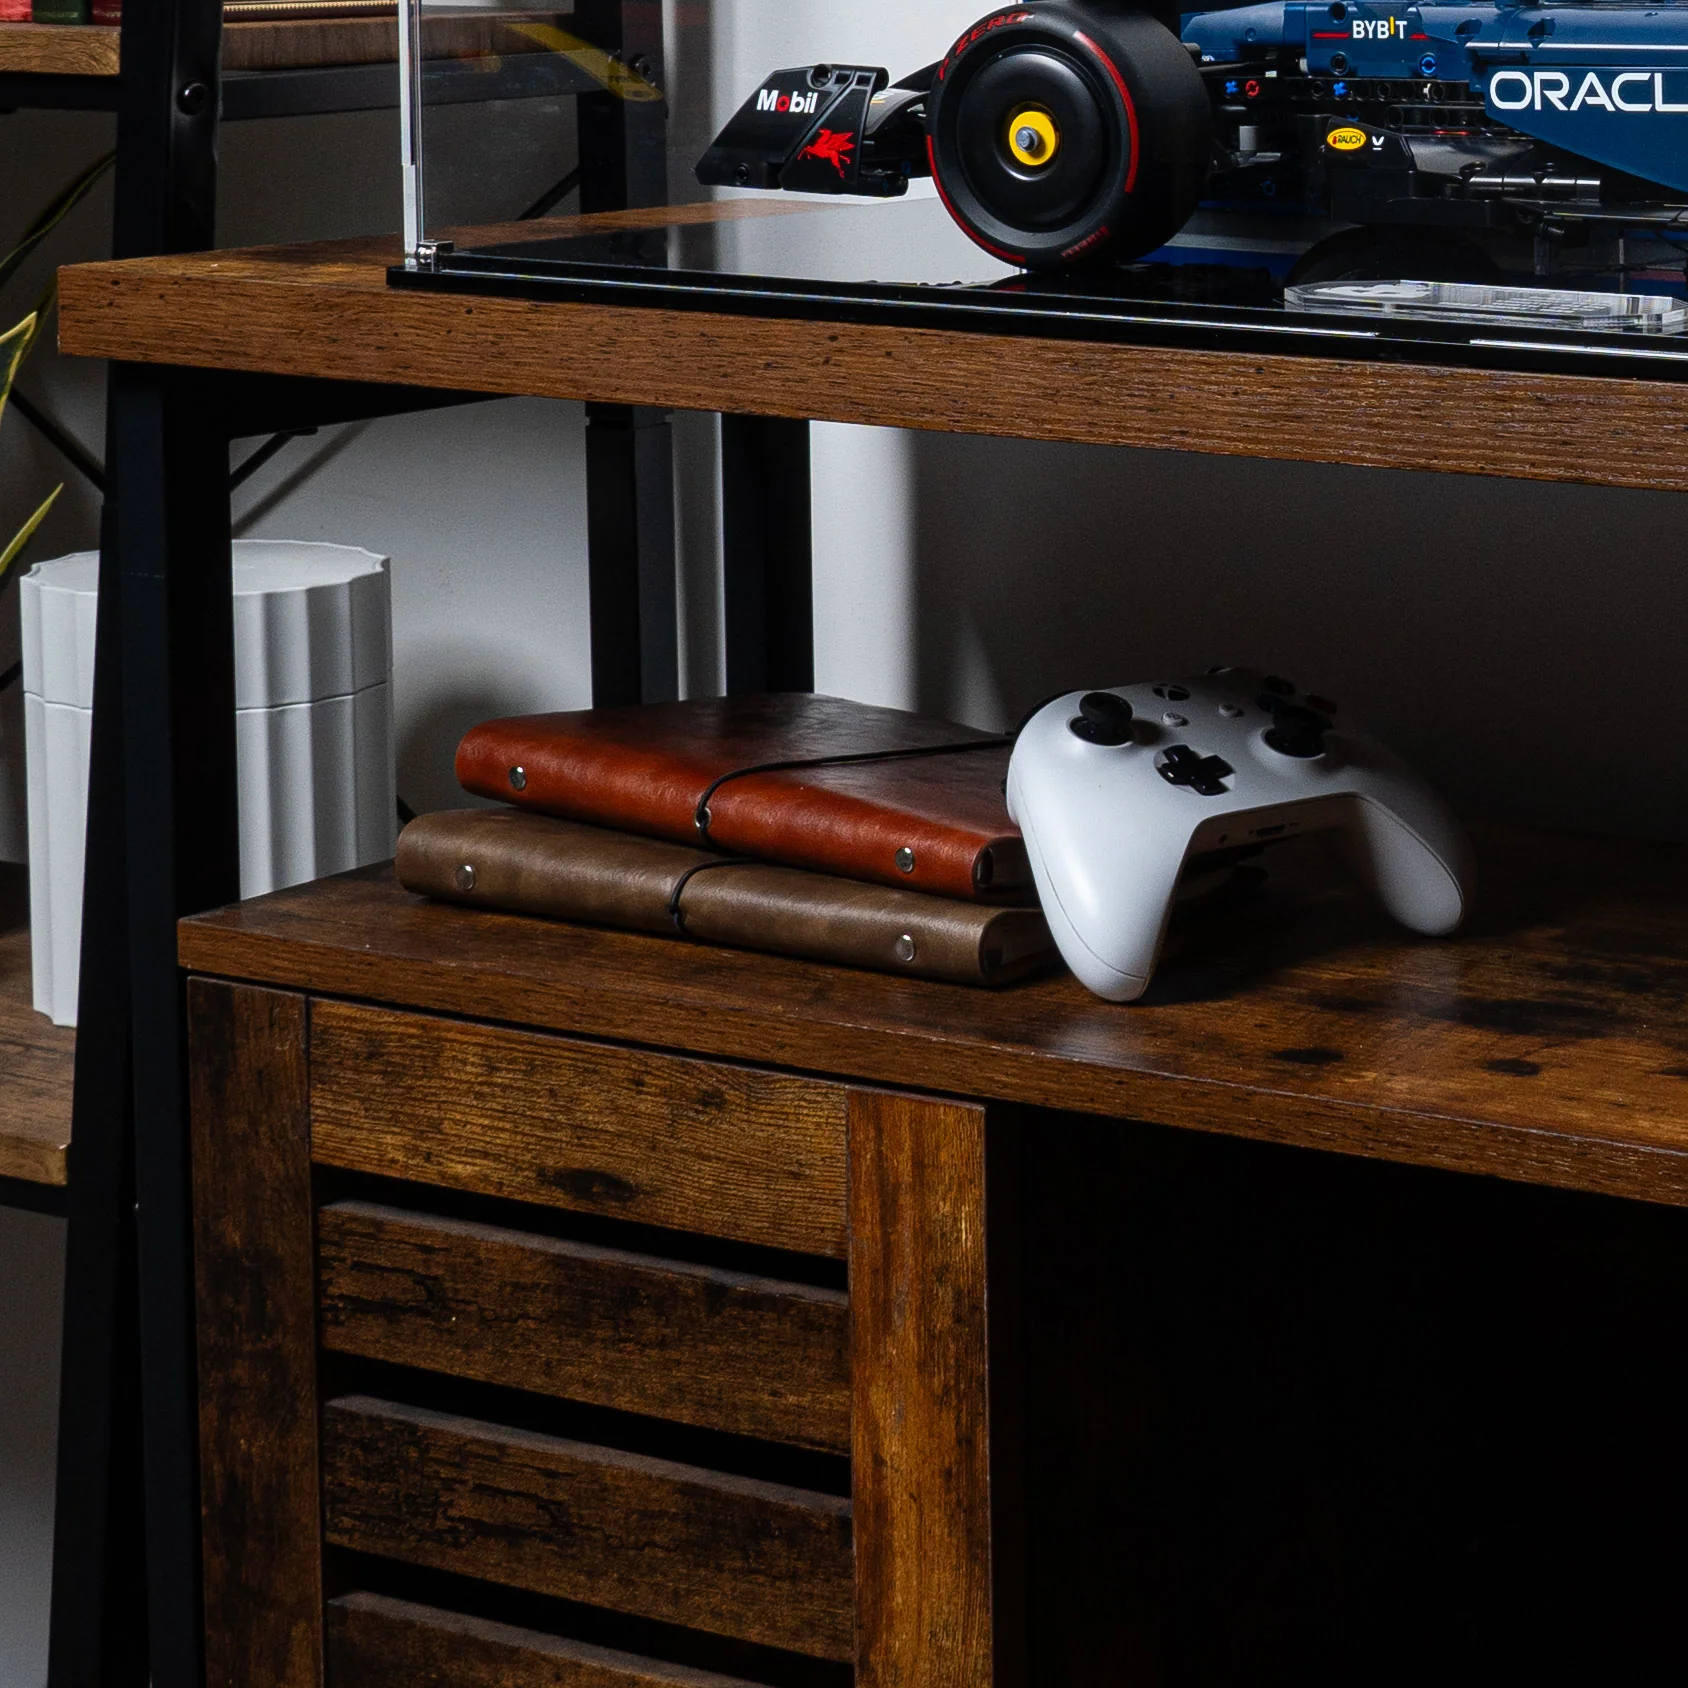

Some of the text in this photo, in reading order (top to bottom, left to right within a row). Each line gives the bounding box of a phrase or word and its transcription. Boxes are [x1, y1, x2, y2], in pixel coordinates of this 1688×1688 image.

[1352, 16, 1408, 40] BYBIT
[756, 88, 819, 113] Mobil
[1337, 134, 1362, 144] RAUCH
